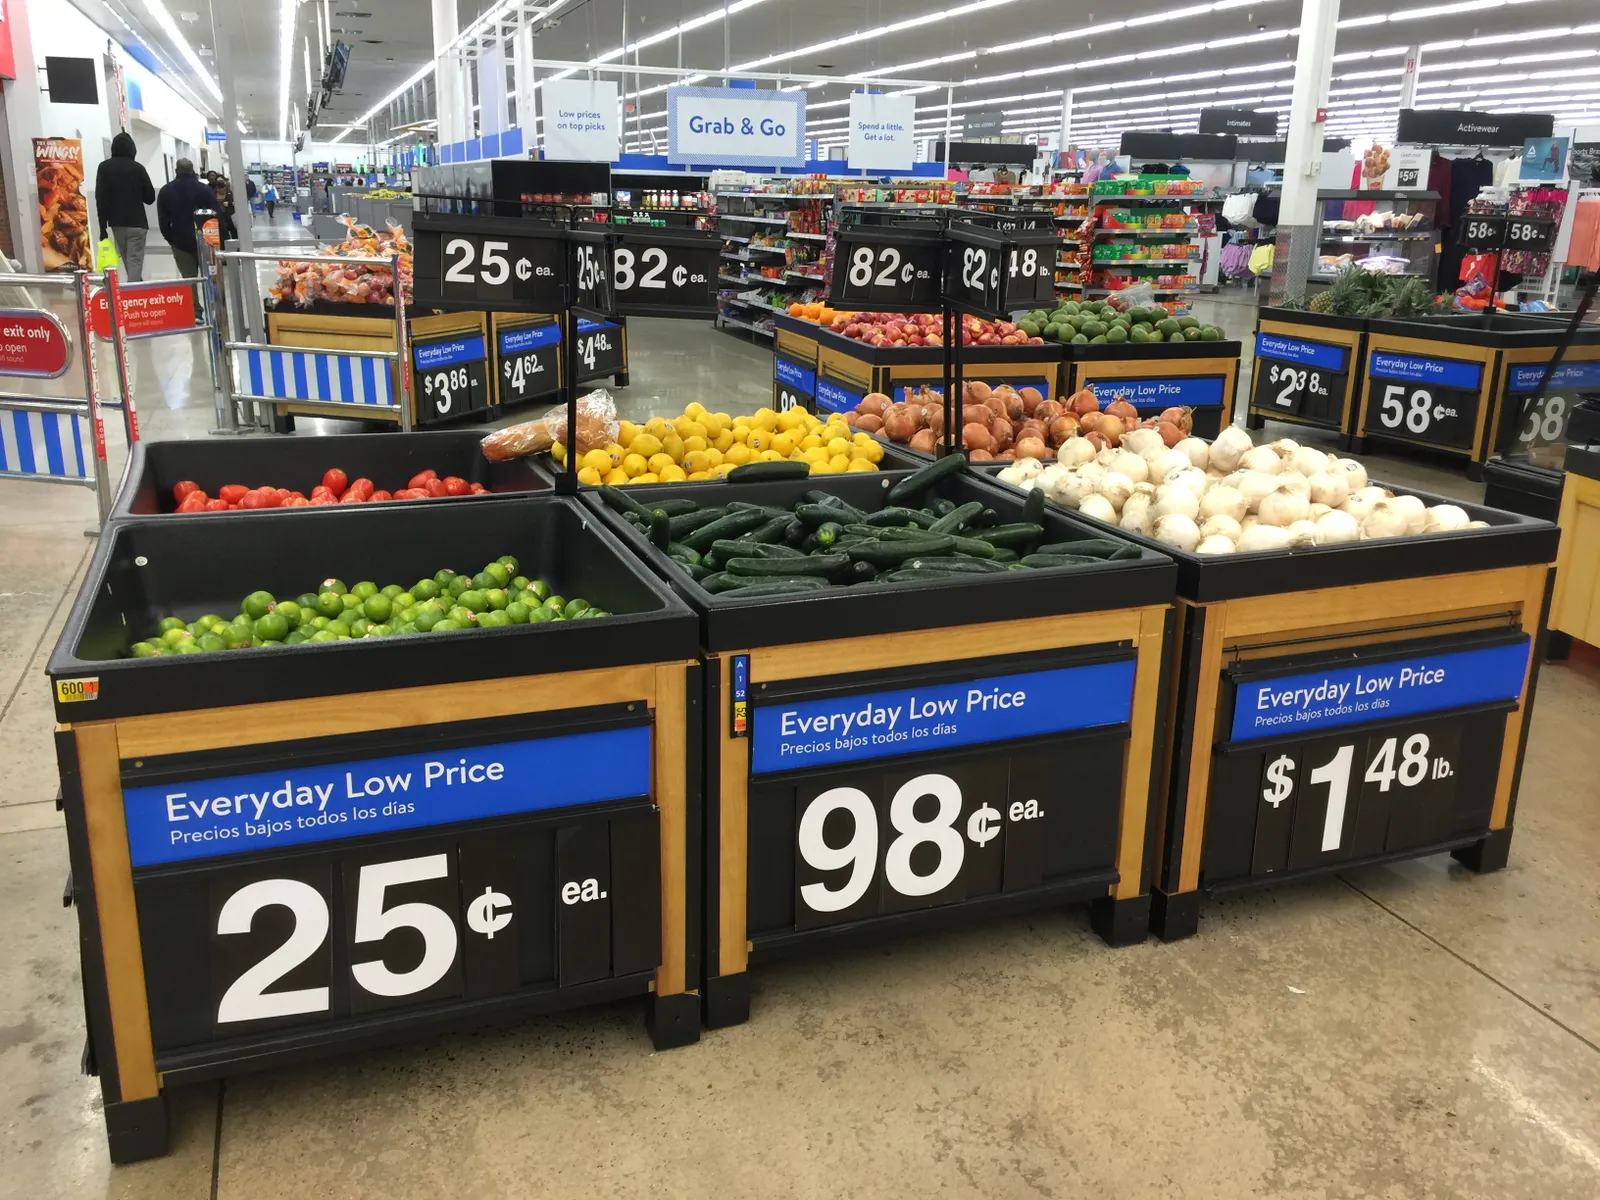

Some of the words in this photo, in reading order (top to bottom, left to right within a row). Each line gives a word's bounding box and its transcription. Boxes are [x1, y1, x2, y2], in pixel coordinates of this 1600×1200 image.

[559, 109, 575, 118] Low
[577, 110, 600, 120] prices
[569, 122, 583, 132] top
[584, 122, 606, 132] picks
[689, 115, 734, 135] Grab
[740, 117, 754, 135] &
[760, 118, 786, 136] Go
[858, 122, 880, 132] Spend
[886, 122, 904, 131] little.
[1226, 119, 1251, 127] Intimates
[1458, 123, 1500, 133] Activewear
[864, 133, 877, 141] Get
[884, 133, 895, 141] lot.
[36, 146, 80, 160] WINGS!
[535, 266, 554, 277] ea.
[690, 272, 708, 283] ea.
[916, 269, 930, 279] ea.
[1040, 266, 1050, 276] lb.
[149, 294, 165, 304] exit
[166, 292, 184, 306] only
[124, 309, 140, 319] Push
[150, 309, 166, 318] open
[3, 324, 25, 337] exit
[27, 325, 50, 343] only
[5, 344, 27, 355] open
[418, 347, 442, 358] Everyday
[442, 346, 451, 354] Low
[452, 343, 464, 352] Price
[1262, 338, 1287, 352] Everyday
[1288, 342, 1300, 352] Low
[1301, 345, 1315, 355] Price
[121, 336, 135, 402] CAUTION
[1376, 357, 1408, 370] Everyday
[1409, 360, 1424, 370] Low
[1425, 362, 1444, 373] Price
[90, 342, 102, 409] CAUTION
[1566, 368, 1584, 377] Price
[1093, 386, 1135, 398] Everyday
[1138, 384, 1157, 395] Low
[1158, 384, 1181, 394] Price
[1318, 386, 1328, 396] ea.
[1445, 407, 1458, 418] ea.
[61, 681, 84, 695] 600
[735, 690, 745, 698] 52
[1256, 679, 1350, 709] Everyday
[1355, 674, 1394, 695] Low
[1398, 666, 1445, 689] Price
[737, 708, 746, 718] 52
[781, 703, 902, 736] Everyday
[909, 696, 958, 720] Low
[966, 687, 1026, 713] Price
[1255, 714, 1293, 728] Precios
[1296, 710, 1322, 722] bajos
[1324, 705, 1353, 718] todos
[1355, 701, 1369, 712] los
[1371, 698, 1390, 709] días
[780, 740, 831, 756] Precios
[834, 736, 868, 751] bajos
[872, 729, 908, 744] todos
[911, 727, 929, 739] los
[932, 723, 957, 736] días
[1432, 757, 1454, 780] lb.
[165, 780, 334, 822] Everyday
[345, 771, 412, 799] Low
[424, 758, 505, 788] Price
[1008, 799, 1045, 822] ea.
[170, 826, 240, 845] Precios
[245, 821, 292, 839] bajos
[297, 811, 348, 830] todos
[352, 806, 378, 821] los
[382, 801, 415, 816] días
[560, 878, 608, 906] ea.
